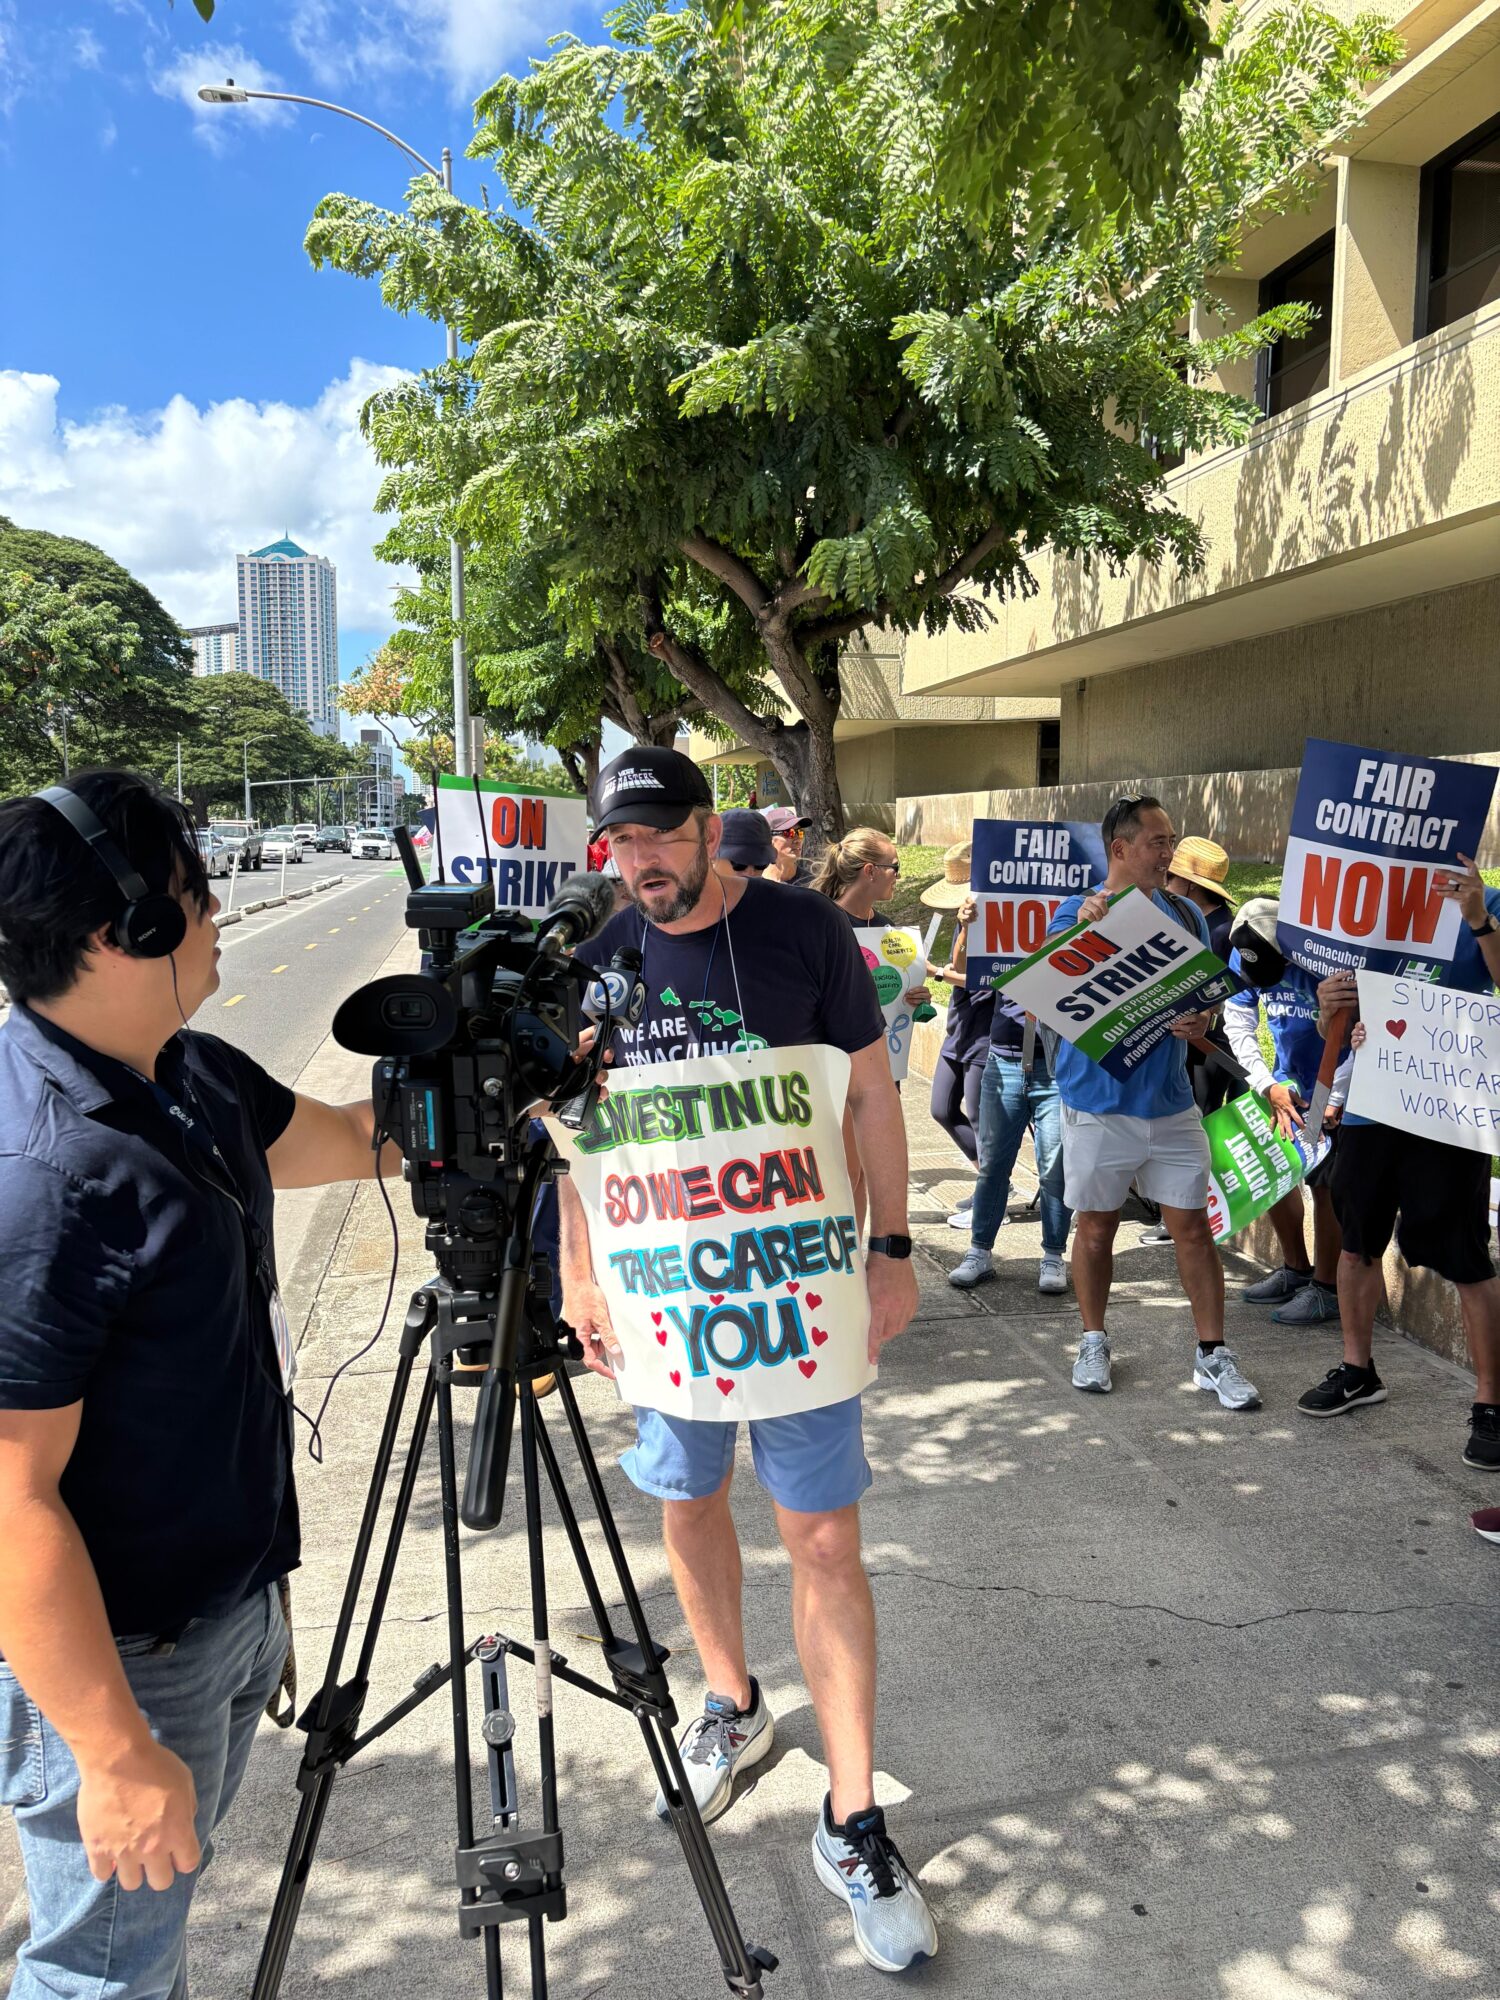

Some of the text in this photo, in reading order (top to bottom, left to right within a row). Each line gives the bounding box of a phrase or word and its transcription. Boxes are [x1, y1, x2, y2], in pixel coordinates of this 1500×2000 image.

[1352, 758, 1436, 811] FAIR
[492, 796, 547, 850] ON
[1014, 828, 1071, 860] FAIR
[1315, 798, 1459, 851] CONTRACT
[989, 860, 1092, 889] CONTRACT
[1299, 852, 1447, 944] NOW
[138, 926, 157, 943] SONY
[1048, 930, 1123, 976] ON
[1304, 938, 1367, 970] @unacuhcp
[1056, 931, 1189, 1022] STRIKE
[1118, 984, 1166, 1014] To Protect
[1276, 992, 1296, 1002] ARE
[1102, 969, 1209, 1043] Our Professions
[1122, 1008, 1177, 1048] @unacuhcp
[620, 1017, 688, 1044] WE ARE
[1422, 1025, 1488, 1059] YOUR
[573, 1084, 706, 1155] INVEST
[704, 1079, 766, 1132] IN
[760, 1070, 813, 1128] US
[1235, 1096, 1275, 1147] SAFETY
[1219, 1169, 1242, 1194] for
[1223, 1131, 1271, 1202] PATIENT
[1263, 1142, 1291, 1174] and
[605, 1146, 825, 1227] SO WE CAN
[608, 1215, 858, 1297] TAKE CARE OF
[665, 1297, 810, 1377] YOU
